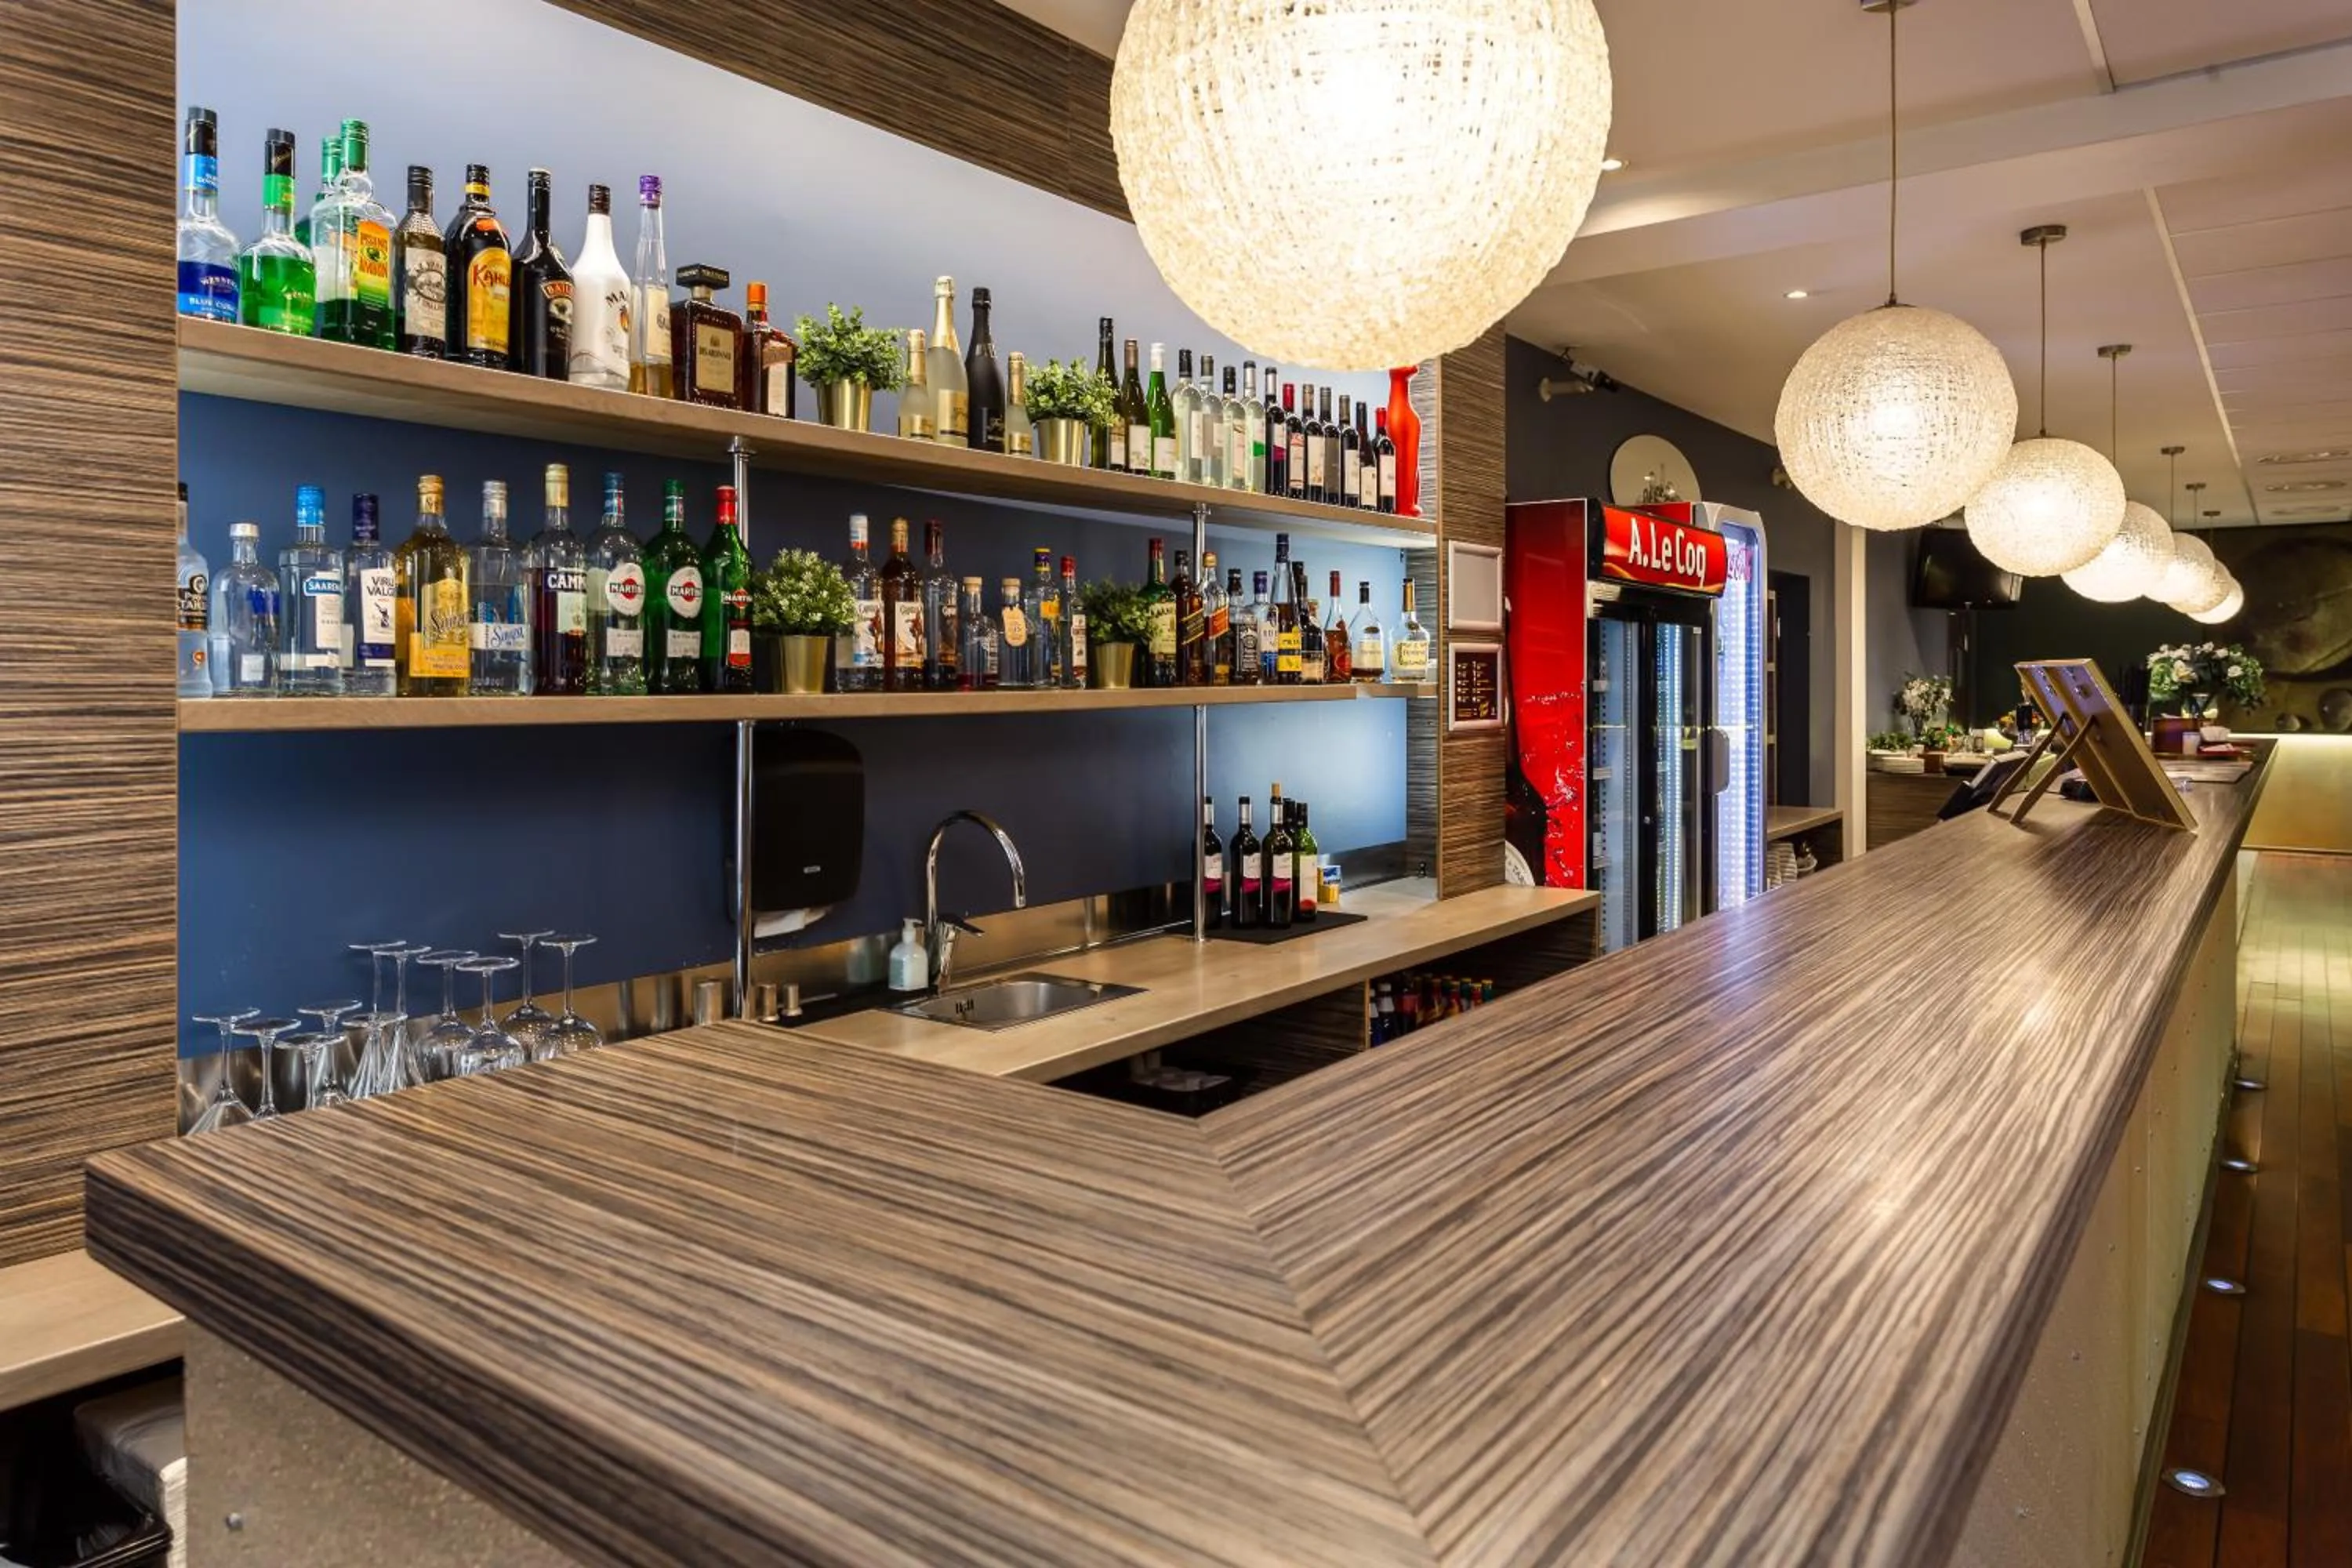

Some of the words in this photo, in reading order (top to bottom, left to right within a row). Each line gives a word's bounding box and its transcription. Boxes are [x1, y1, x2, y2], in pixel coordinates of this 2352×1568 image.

[1628, 517, 1649, 568] A.
[1650, 521, 1673, 572] Le
[1675, 527, 1707, 590] Coq
